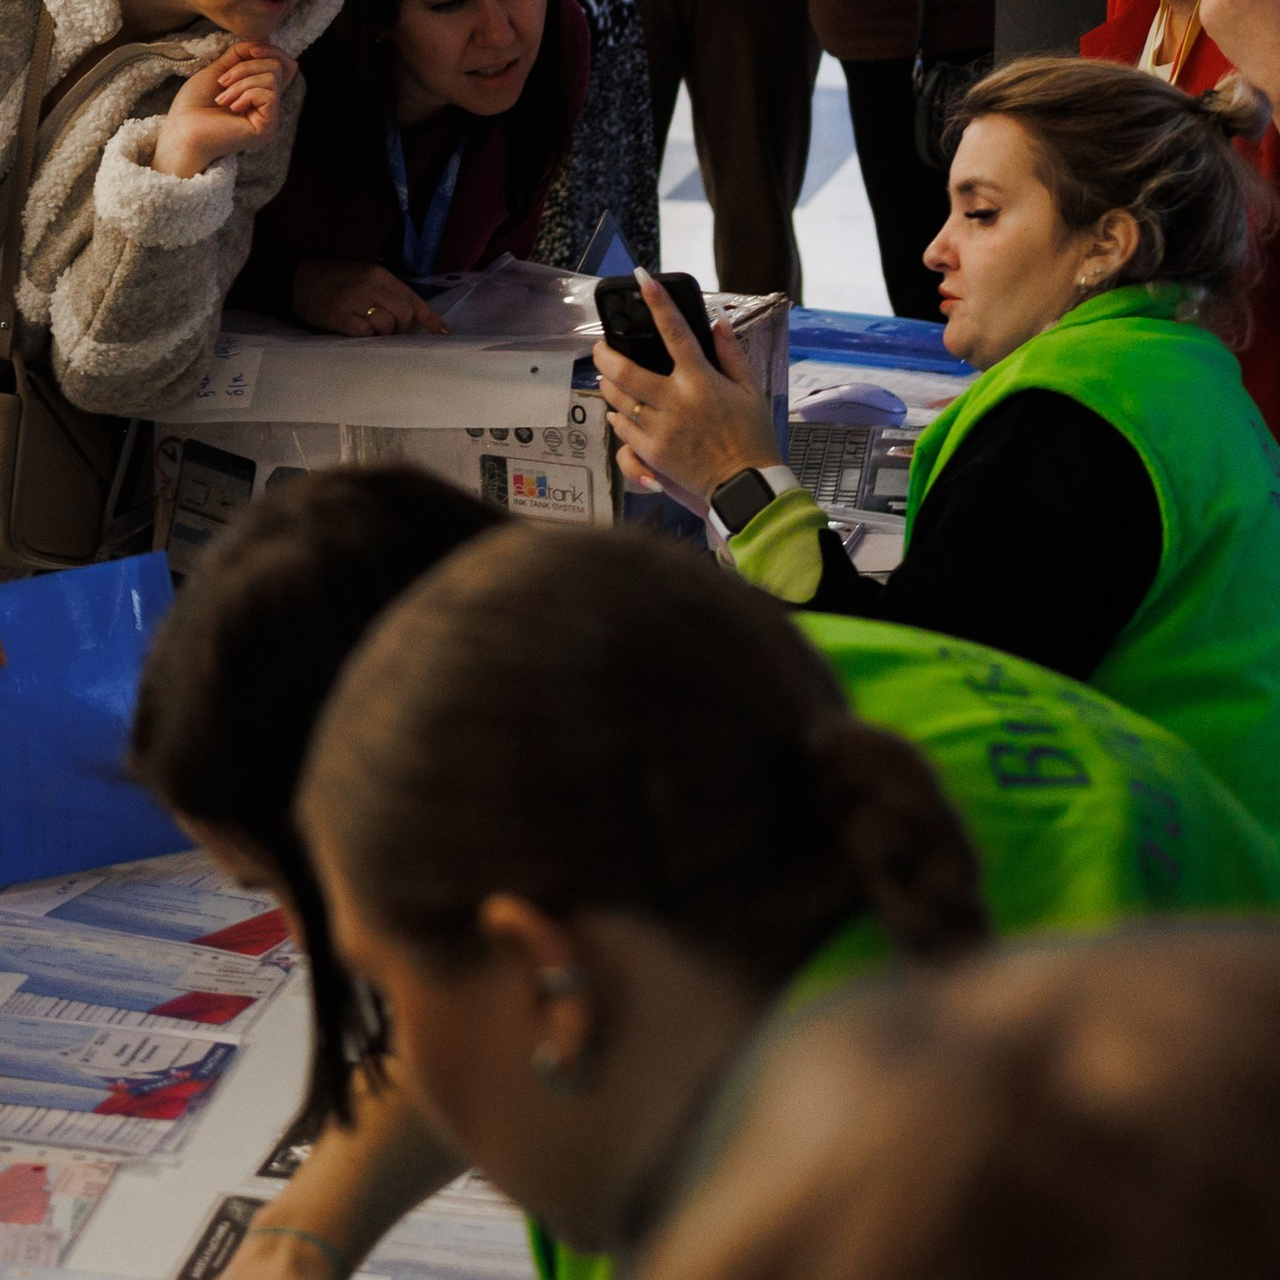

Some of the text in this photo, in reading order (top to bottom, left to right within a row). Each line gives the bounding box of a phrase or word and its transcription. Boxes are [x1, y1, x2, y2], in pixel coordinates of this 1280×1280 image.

[513, 498, 586, 514] INK TANK SYSTEM
